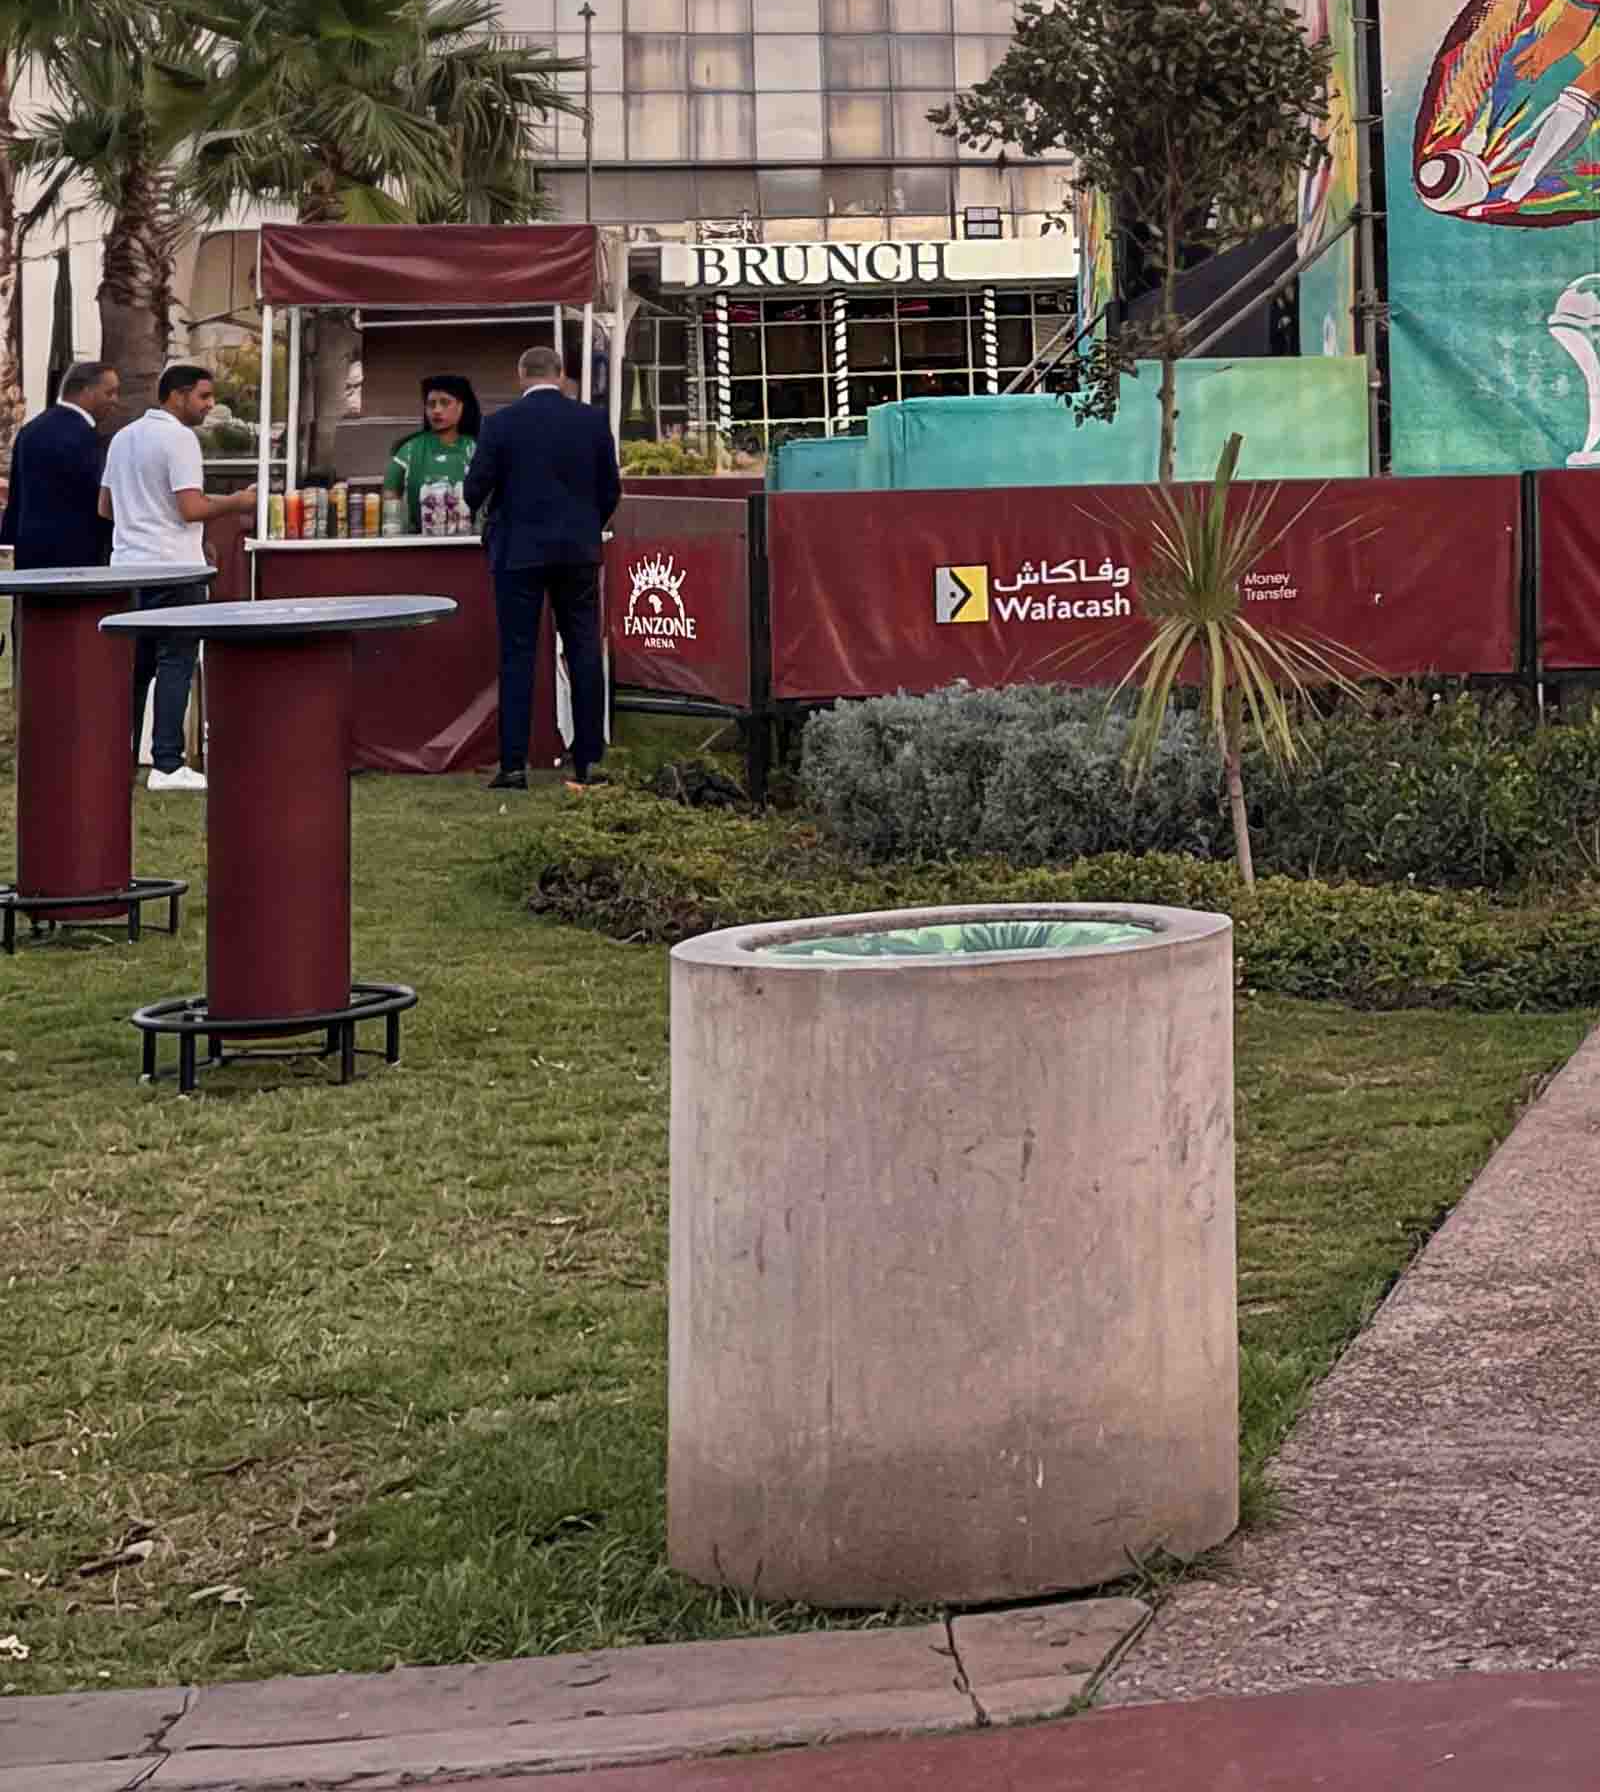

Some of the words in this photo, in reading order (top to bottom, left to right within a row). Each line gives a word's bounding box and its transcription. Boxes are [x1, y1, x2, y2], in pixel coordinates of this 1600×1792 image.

[691, 242, 949, 287] BRUNCH
[994, 557, 1130, 591] وفاكاش
[1244, 572, 1291, 586] Money
[1244, 585, 1297, 601] Transfer
[994, 592, 1131, 622] Wafacash
[624, 616, 697, 639] FANZONE
[644, 637, 675, 649] ARENA
